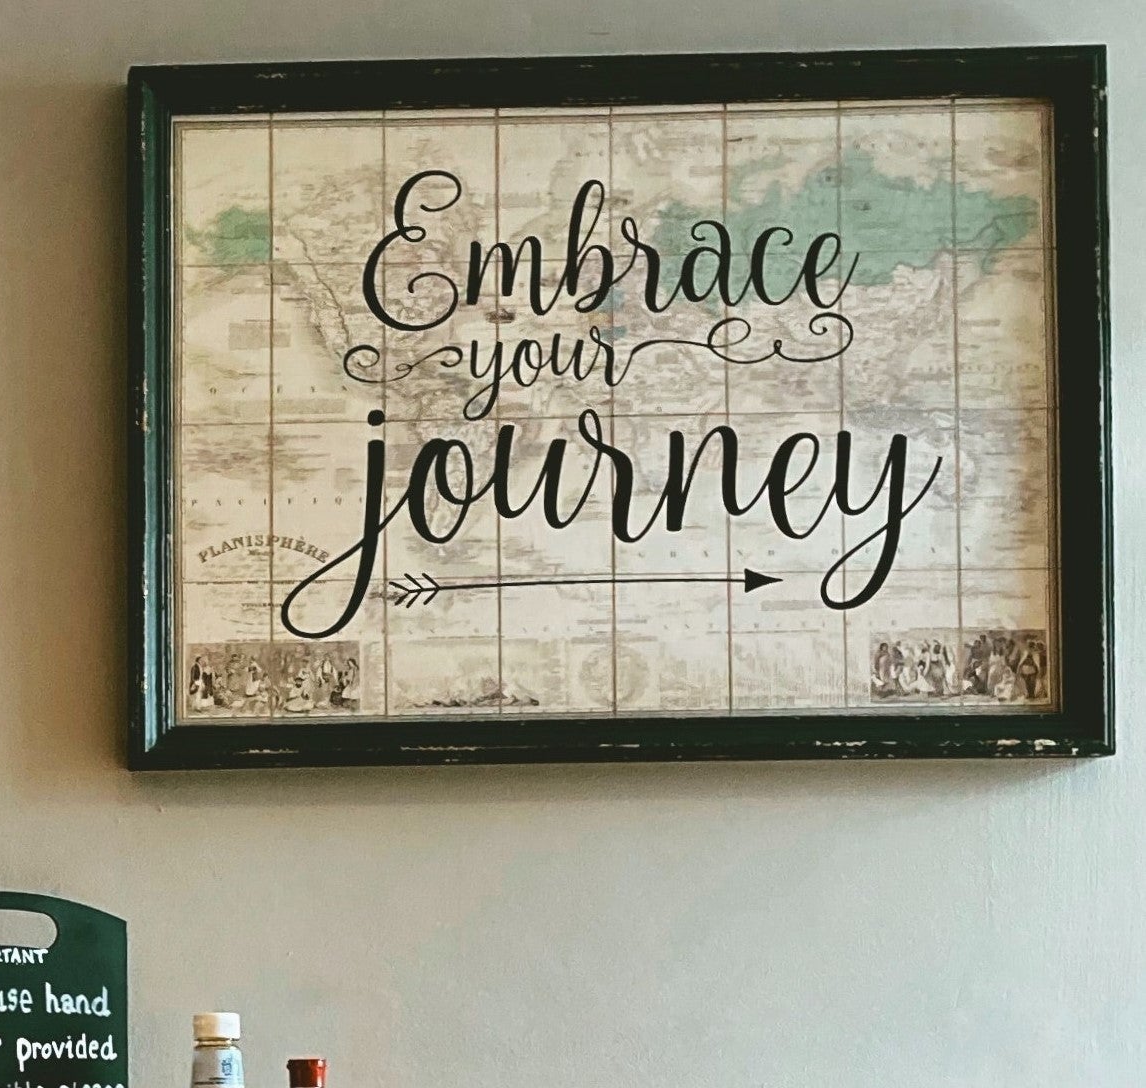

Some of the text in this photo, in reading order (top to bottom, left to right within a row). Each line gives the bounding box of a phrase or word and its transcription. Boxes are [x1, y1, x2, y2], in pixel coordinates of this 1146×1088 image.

[362, 170, 859, 331] Embrace
[282, 409, 942, 639] journey
[198, 534, 330, 563] PLANISPHÈRE
[45, 981, 111, 1017] hand
[16, 1033, 118, 1072] provided
